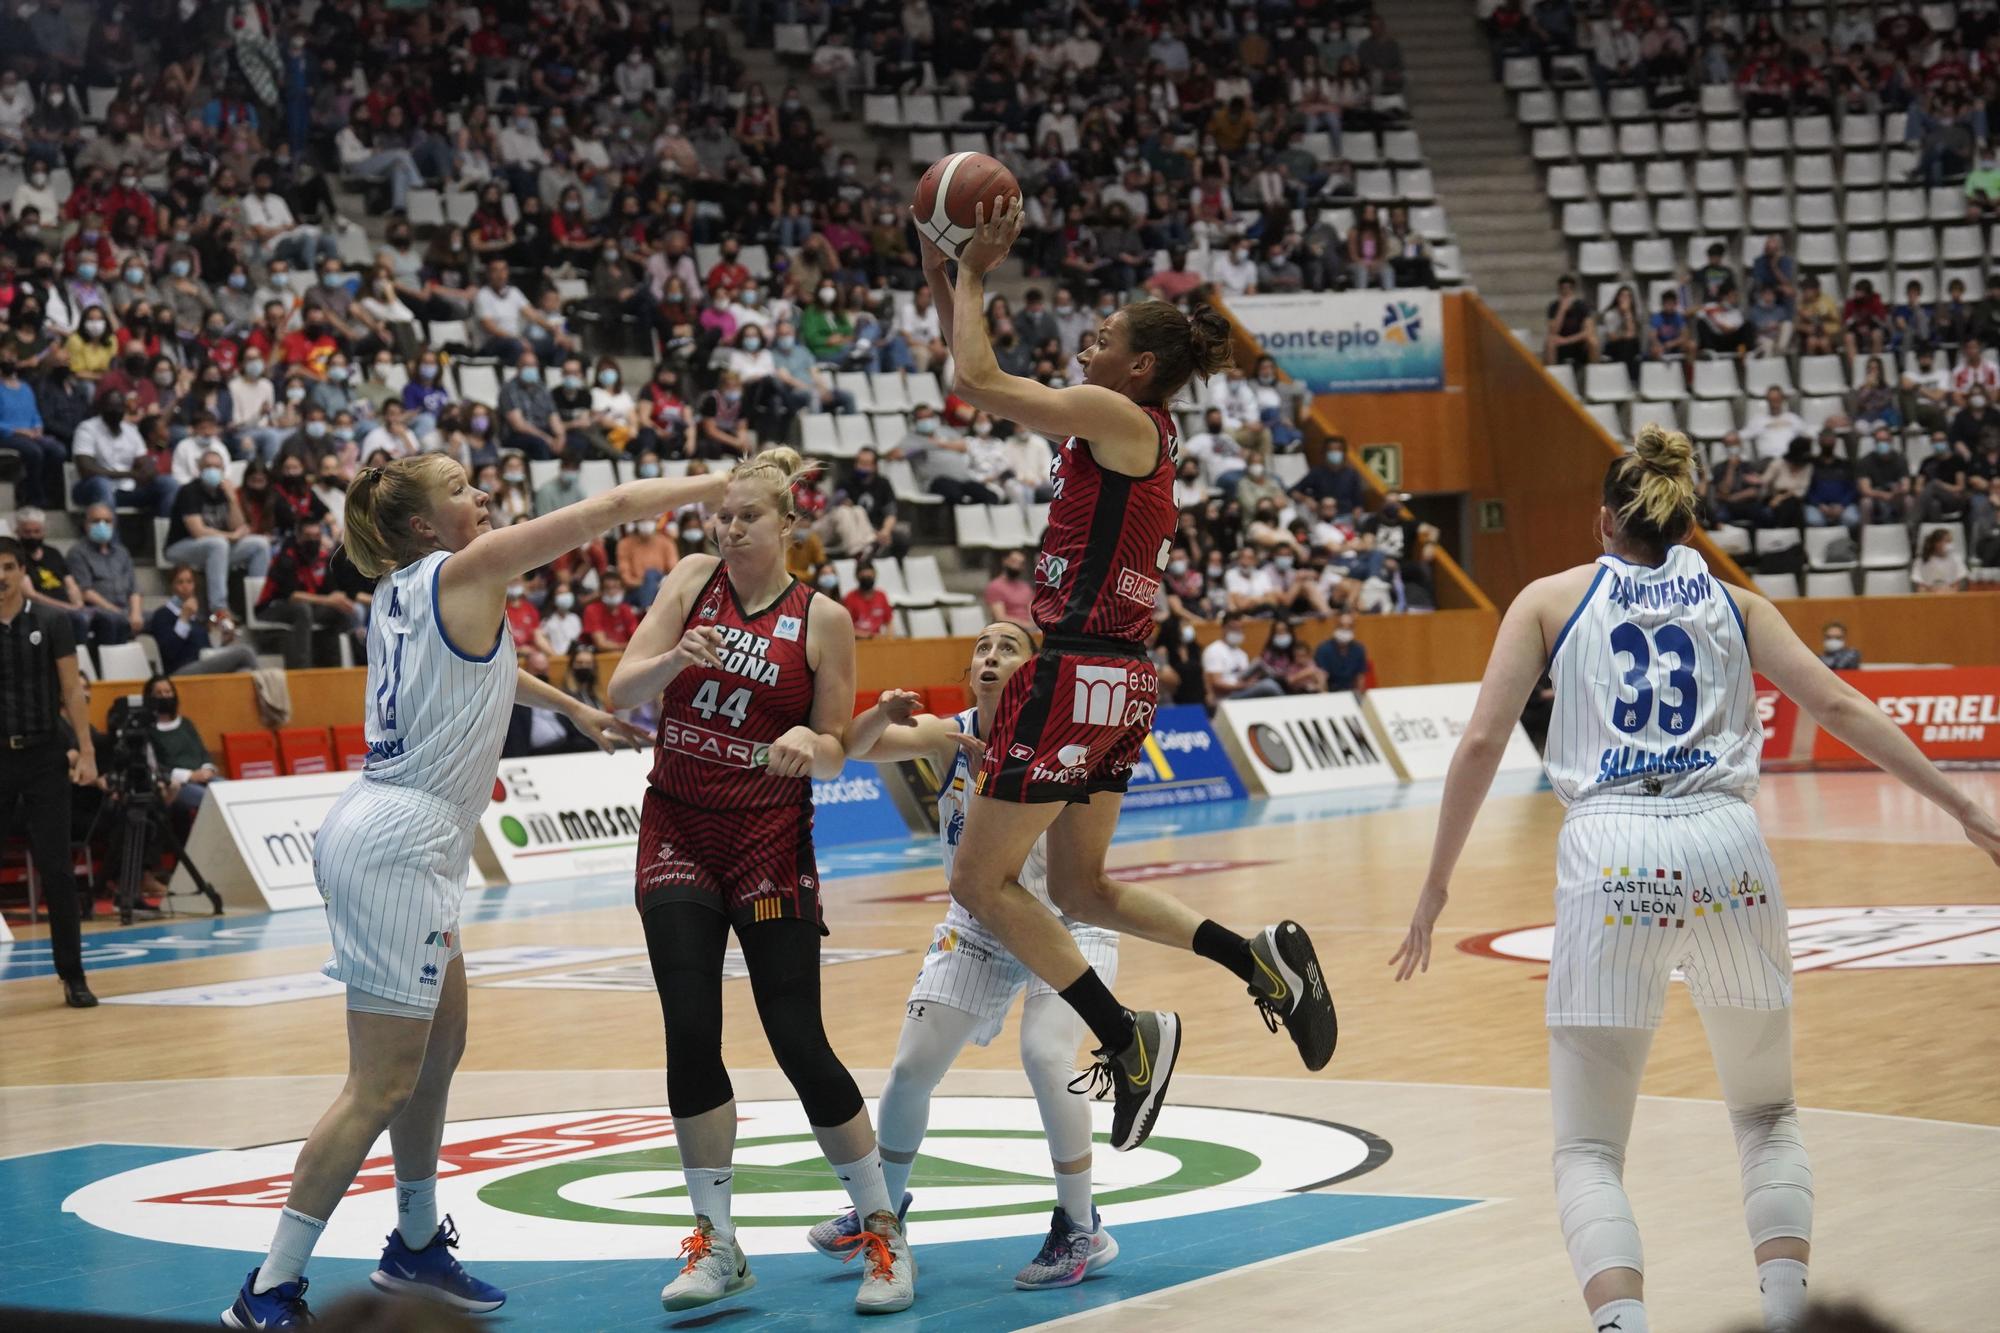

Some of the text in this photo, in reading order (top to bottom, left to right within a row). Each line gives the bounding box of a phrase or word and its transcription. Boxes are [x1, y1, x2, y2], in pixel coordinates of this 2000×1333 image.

[1610, 621, 1698, 736] 33
[691, 680, 753, 728] 44
[1876, 694, 2000, 725] ESTREL
[665, 724, 751, 763] SPAR
[1284, 715, 1381, 771] IMAN
[1922, 725, 1985, 742] DAMM
[263, 820, 319, 867] mi
[650, 872, 696, 885] esportcat
[1602, 881, 1684, 897] CASTILLA
[1692, 887, 1713, 903] es
[1614, 898, 1676, 915] Y LEÓN
